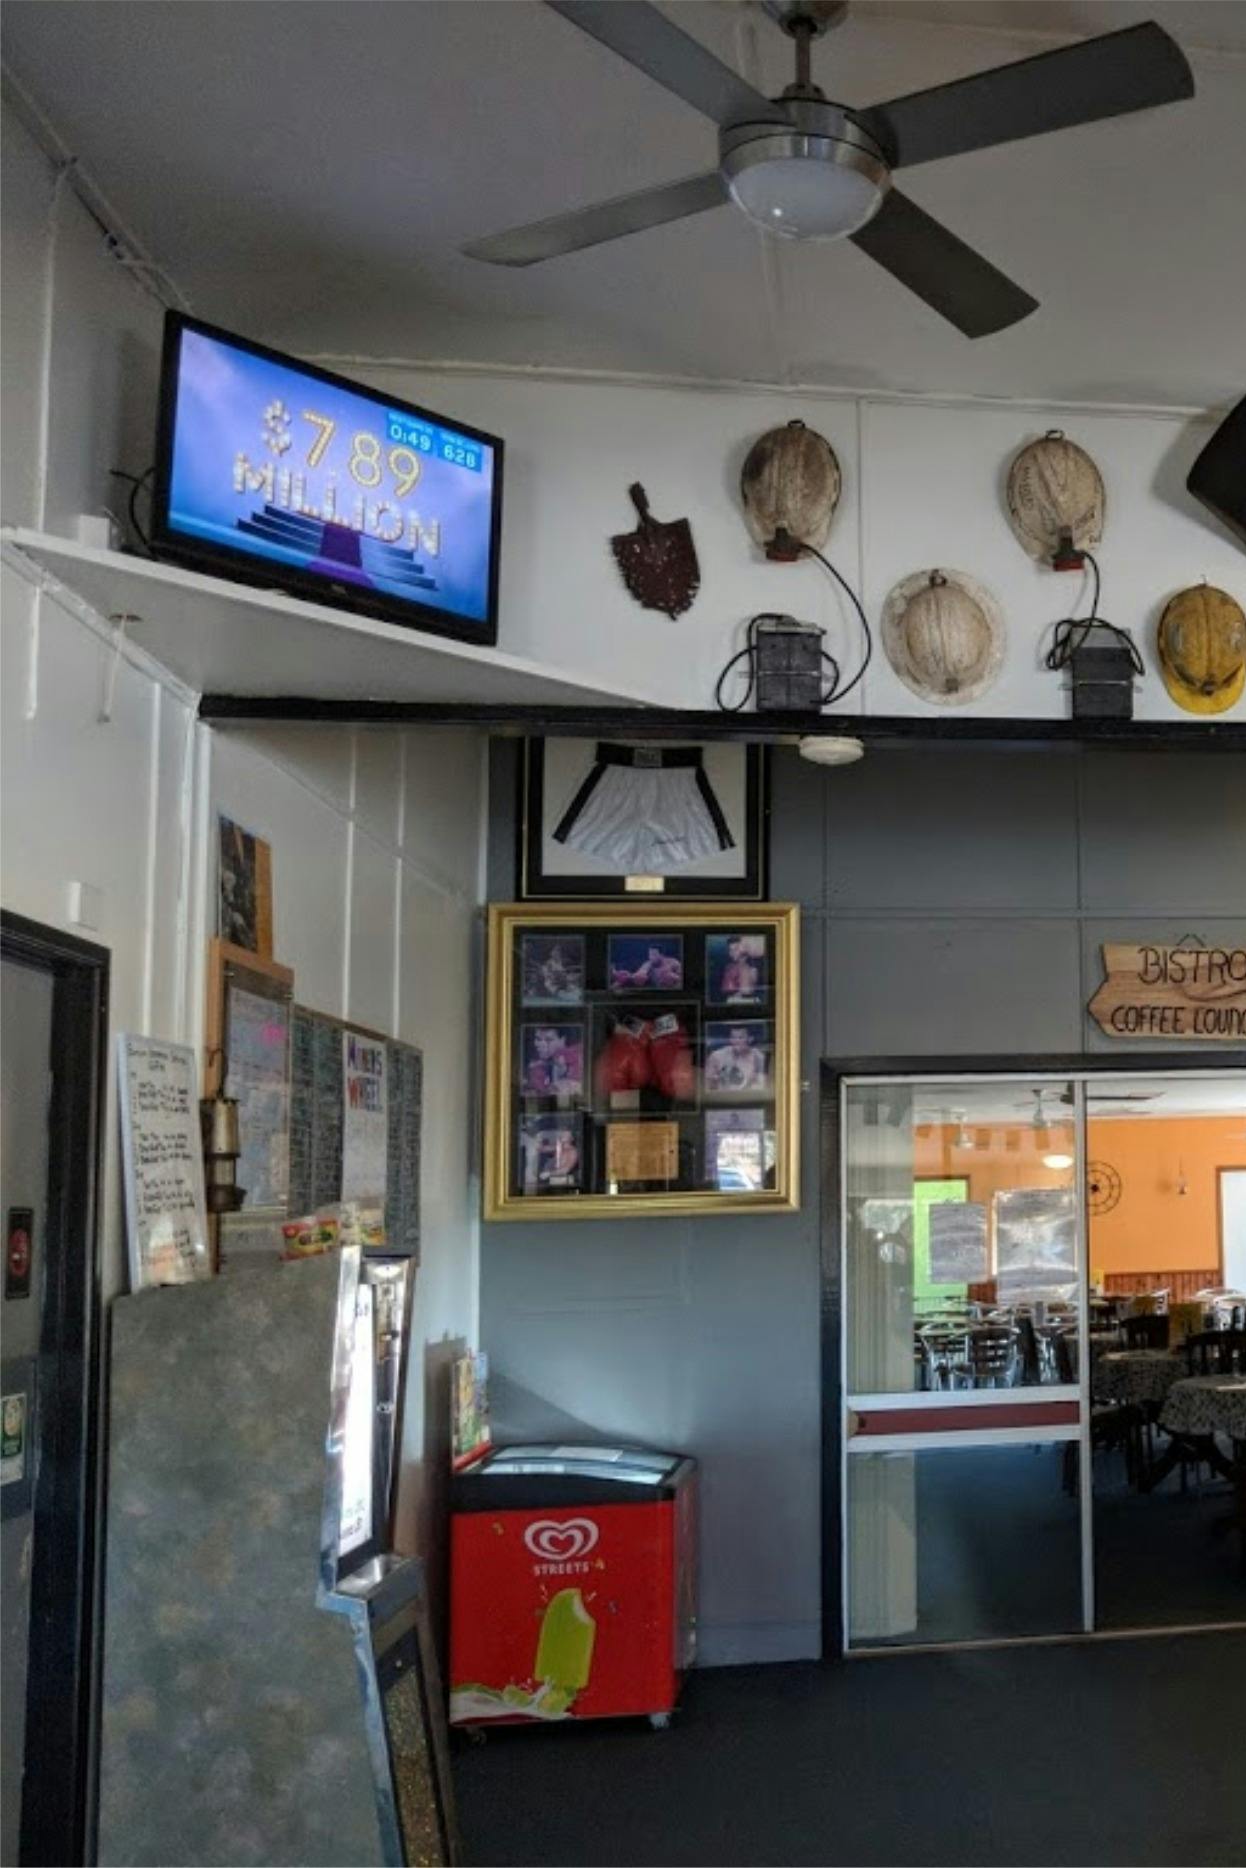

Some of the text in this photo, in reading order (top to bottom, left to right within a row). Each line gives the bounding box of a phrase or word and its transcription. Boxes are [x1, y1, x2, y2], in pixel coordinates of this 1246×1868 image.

[232, 450, 441, 559] MILLION
[1110, 1004, 1186, 1034] COFFEE
[532, 1560, 591, 1577] STREETS
